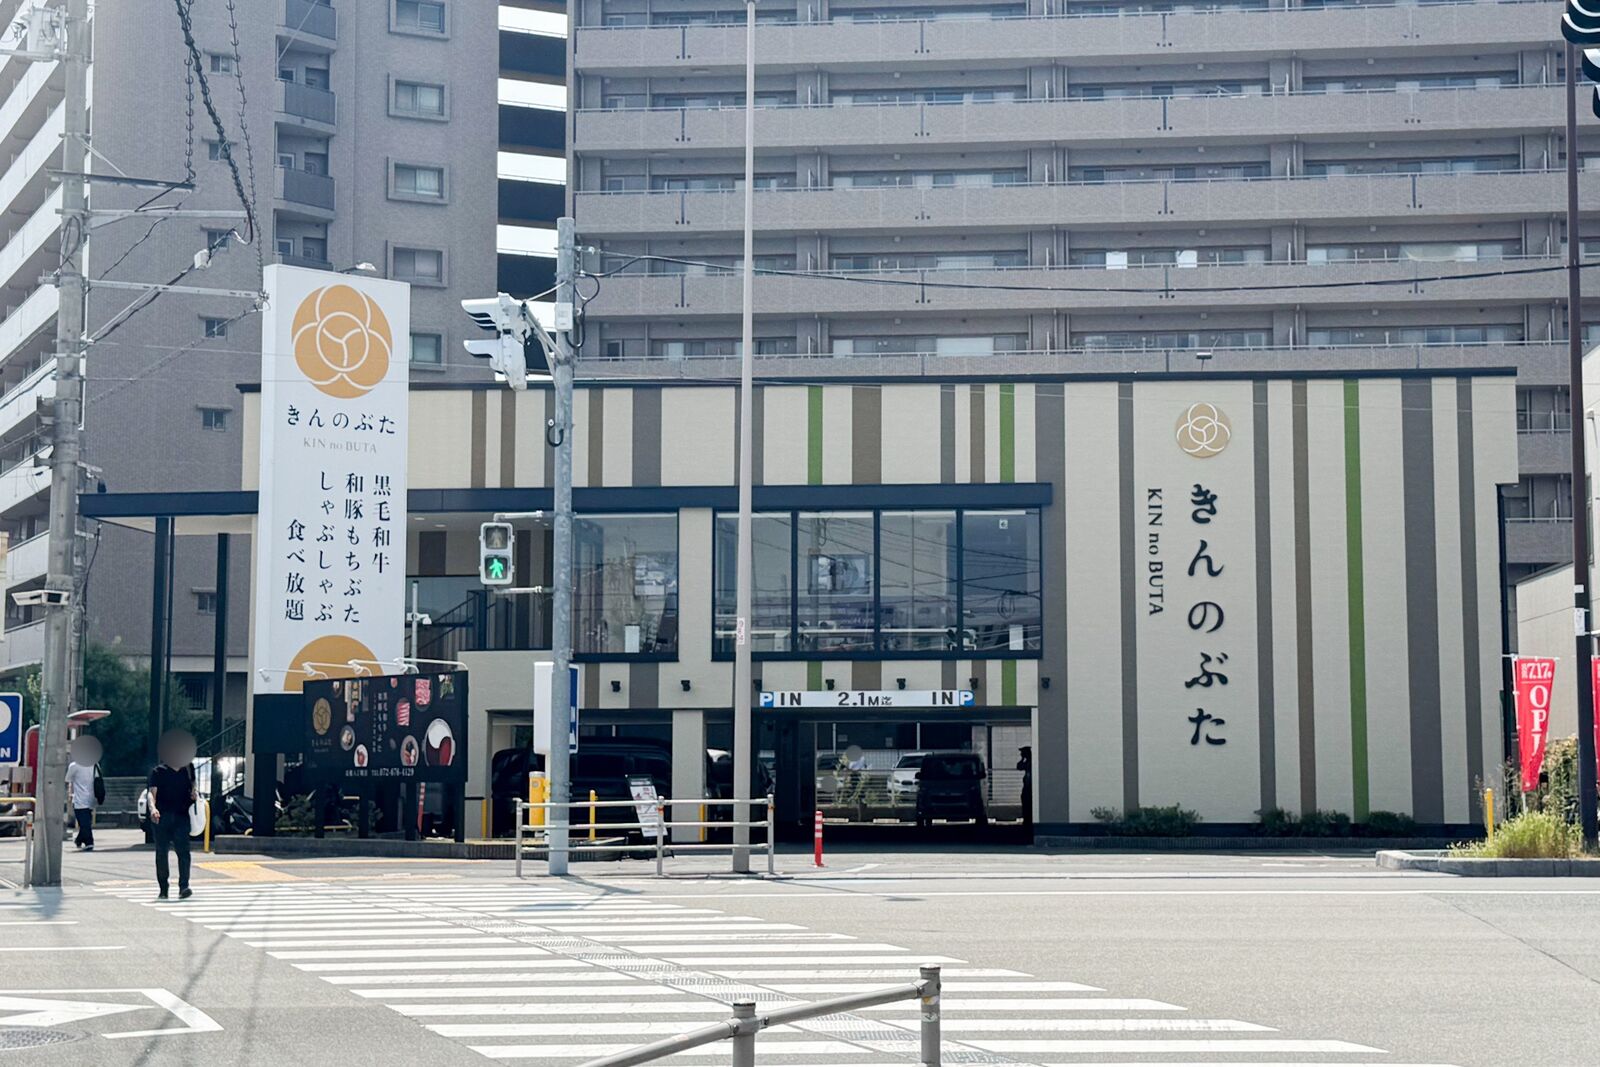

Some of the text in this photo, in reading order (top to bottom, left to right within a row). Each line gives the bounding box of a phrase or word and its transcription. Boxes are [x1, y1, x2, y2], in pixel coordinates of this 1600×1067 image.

[287, 404, 395, 434] きんのぶた
[303, 437, 377, 454] KIN no BUTA
[284, 518, 306, 622] 食べ放題
[314, 471, 335, 621] しゃぶしゃぶ
[344, 472, 364, 623] 和豚もちぶた
[372, 474, 391, 574] 黒毛和牛
[1148, 488, 1164, 616] KIN no BUTA
[1184, 483, 1229, 746] きんのぶた
[759, 692, 774, 707] P
[780, 692, 802, 706] IN
[932, 691, 954, 705] IN
[959, 691, 974, 706] P
